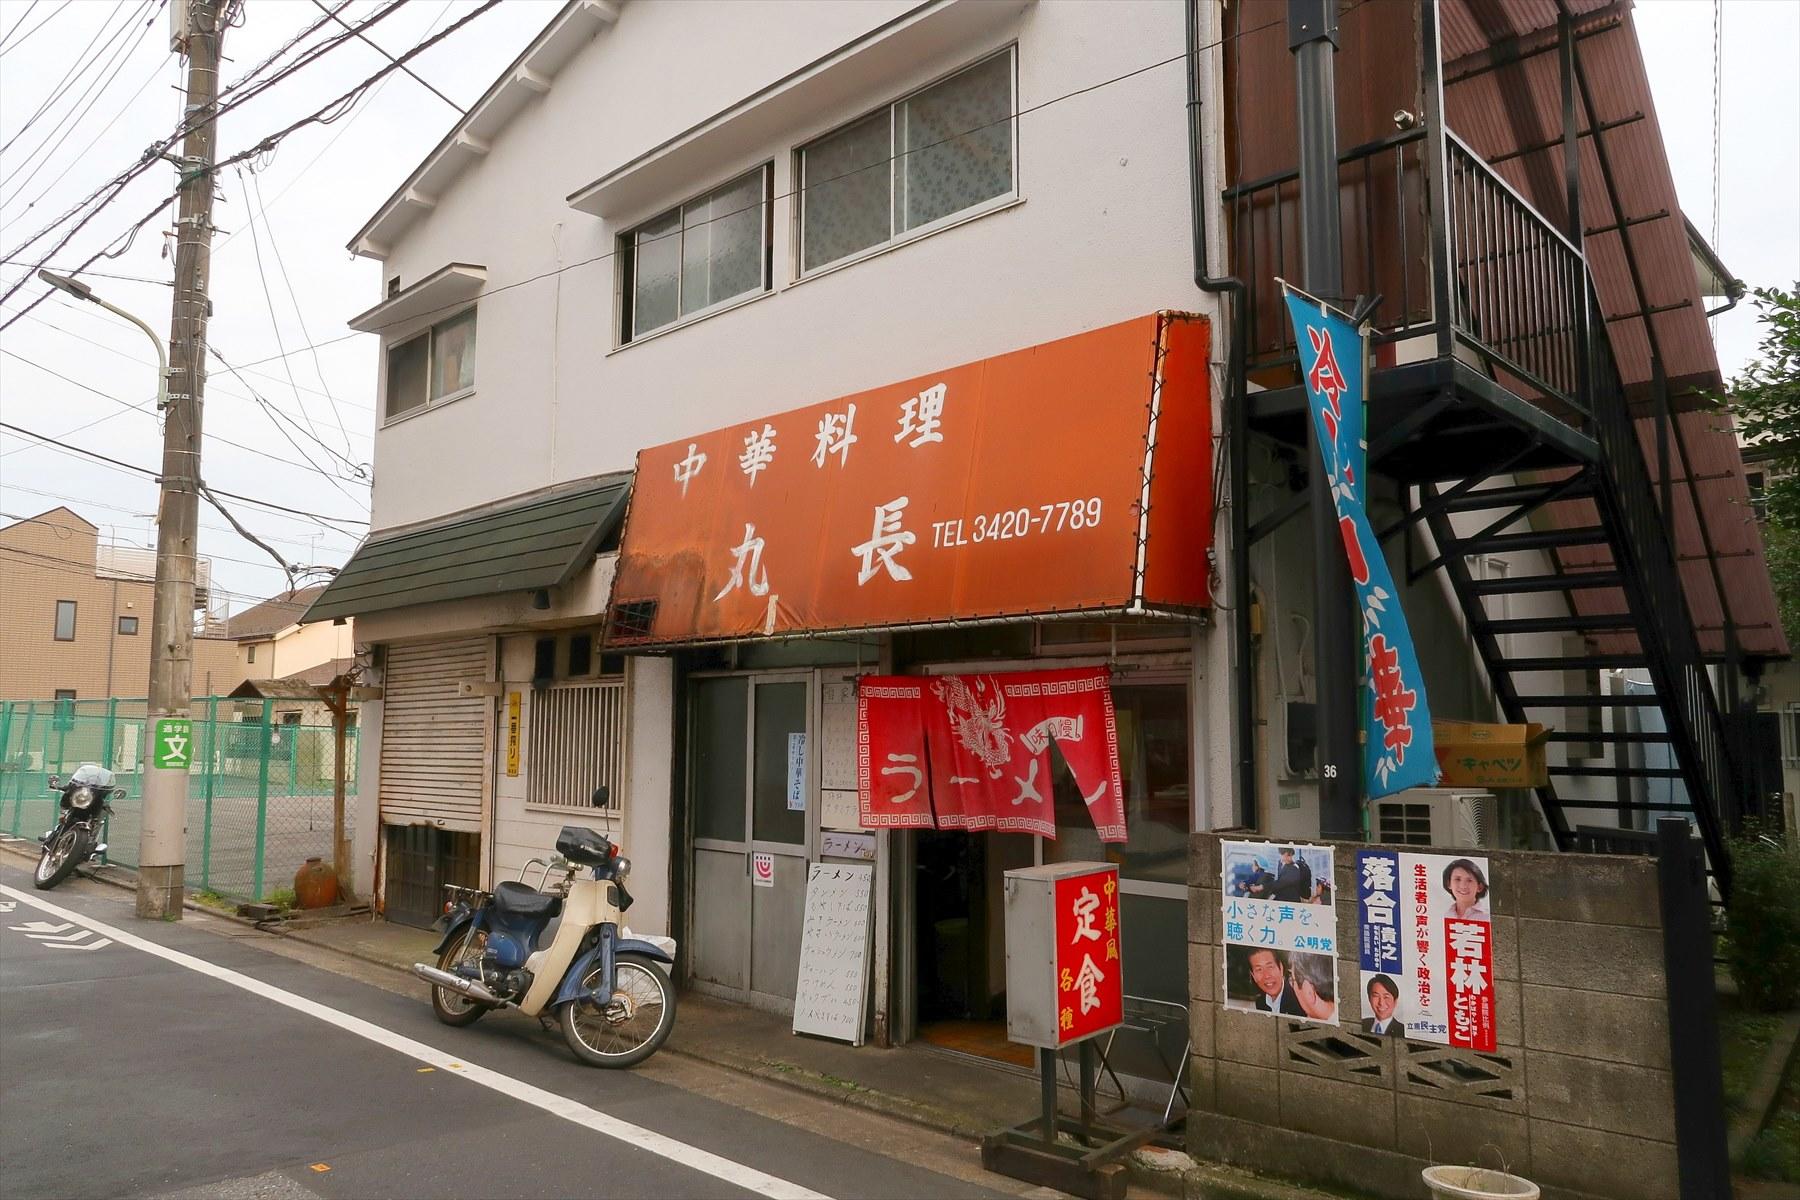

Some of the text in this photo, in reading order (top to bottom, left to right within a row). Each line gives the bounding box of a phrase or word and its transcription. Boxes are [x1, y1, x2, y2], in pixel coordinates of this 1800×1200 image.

[674, 382, 947, 498] 中華料理
[713, 496, 917, 602] 丸長
[932, 497, 1102, 547] TEL 3420-7789
[162, 734, 188, 760] 文
[793, 735, 806, 800] 冷し中華そば
[1324, 764, 1337, 778] 36
[811, 866, 854, 881] ラーメン
[1362, 857, 1397, 925] 落合
[1104, 874, 1119, 961] 中華風
[1227, 901, 1319, 927] 小さな声を、
[1227, 922, 1283, 945] 聴く力。
[1414, 864, 1430, 1006] 生活者の声が響く政治を
[1072, 886, 1105, 1015] 定食
[1295, 936, 1332, 951] 公明党
[1381, 927, 1397, 960] 貴之
[1449, 923, 1487, 995] 若林
[1060, 968, 1074, 1031] 各種
[1454, 994, 1471, 1041] ともこ
